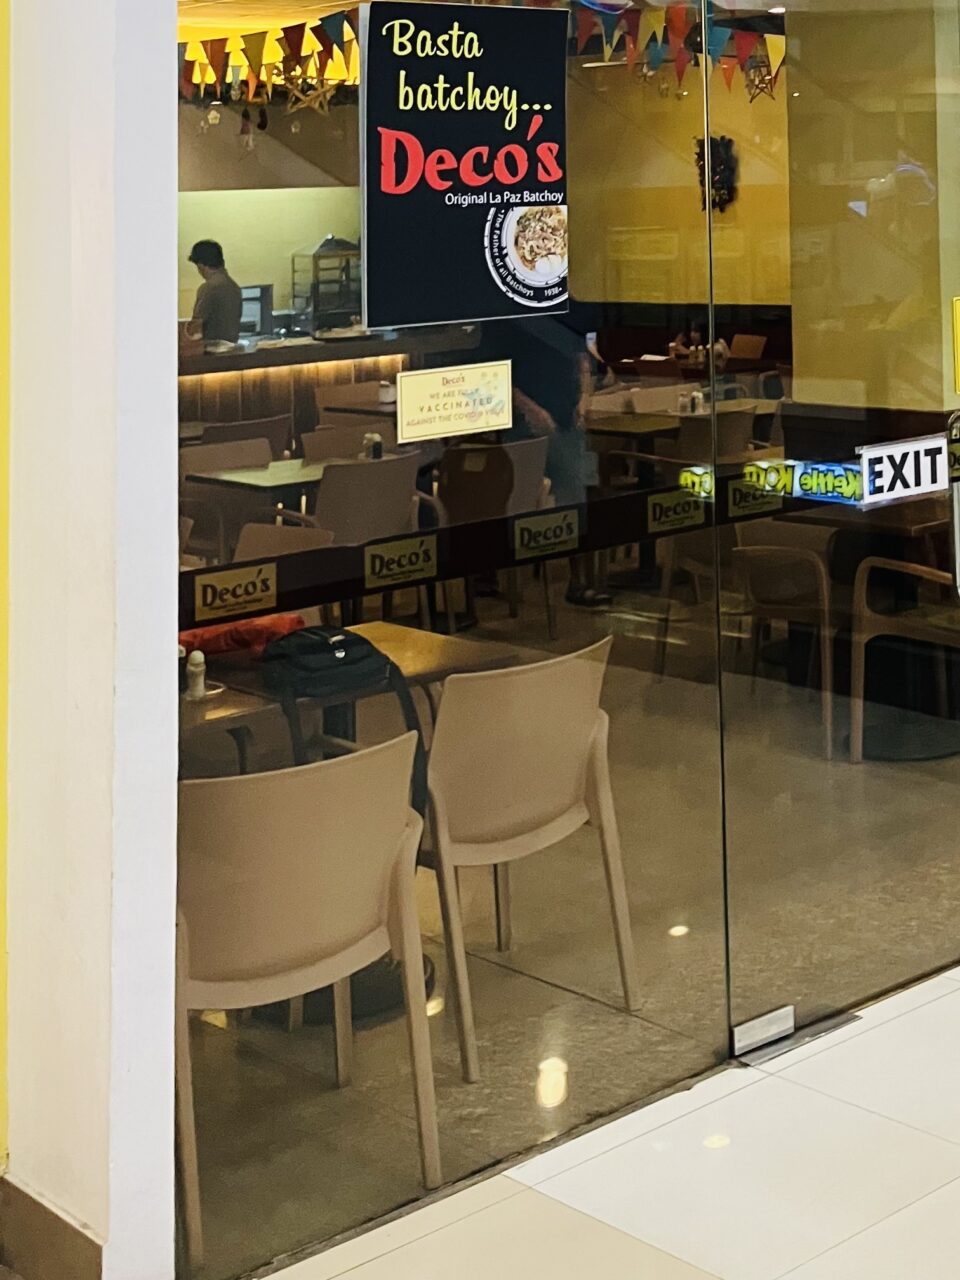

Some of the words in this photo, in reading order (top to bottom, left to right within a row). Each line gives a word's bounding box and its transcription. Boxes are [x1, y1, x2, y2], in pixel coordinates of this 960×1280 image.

[382, 18, 484, 58] Basta
[377, 114, 563, 195] Deco's
[445, 191, 487, 207] Original
[489, 192, 501, 204] La
[504, 191, 521, 203] Paz
[523, 190, 564, 204] Batchoy
[420, 397, 492, 412] VACCINATED
[868, 446, 942, 495] EXIT
[519, 514, 574, 548] Deco's
[370, 539, 432, 577] Deco's
[201, 567, 270, 608] Deco's
